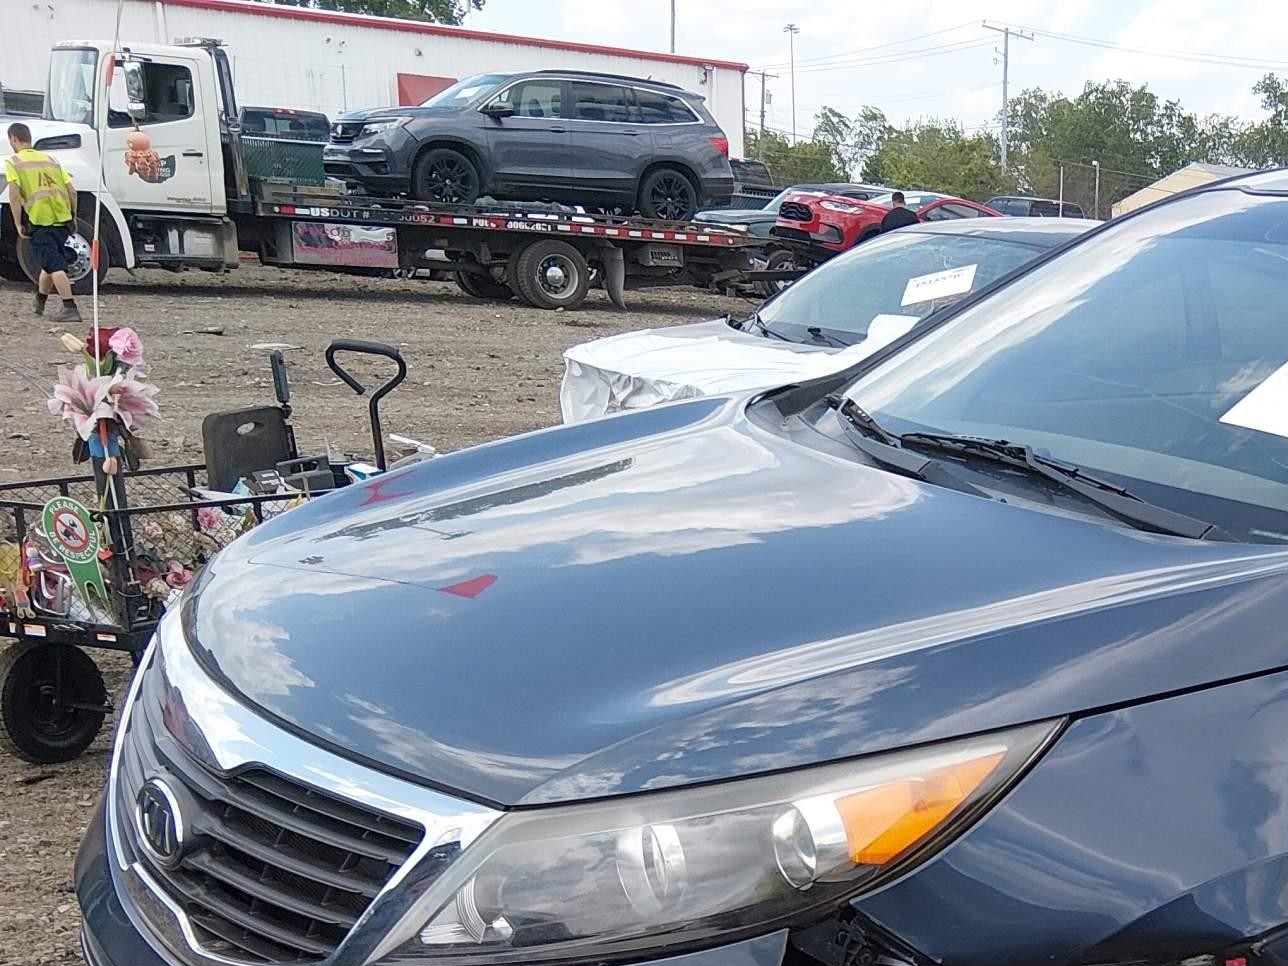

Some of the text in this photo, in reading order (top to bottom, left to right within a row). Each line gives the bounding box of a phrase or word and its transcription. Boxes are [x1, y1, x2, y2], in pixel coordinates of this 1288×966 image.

[310, 207, 359, 219] USDOT
[48, 500, 80, 515] PLEASE
[48, 530, 97, 560] BE RESPECTFUL
